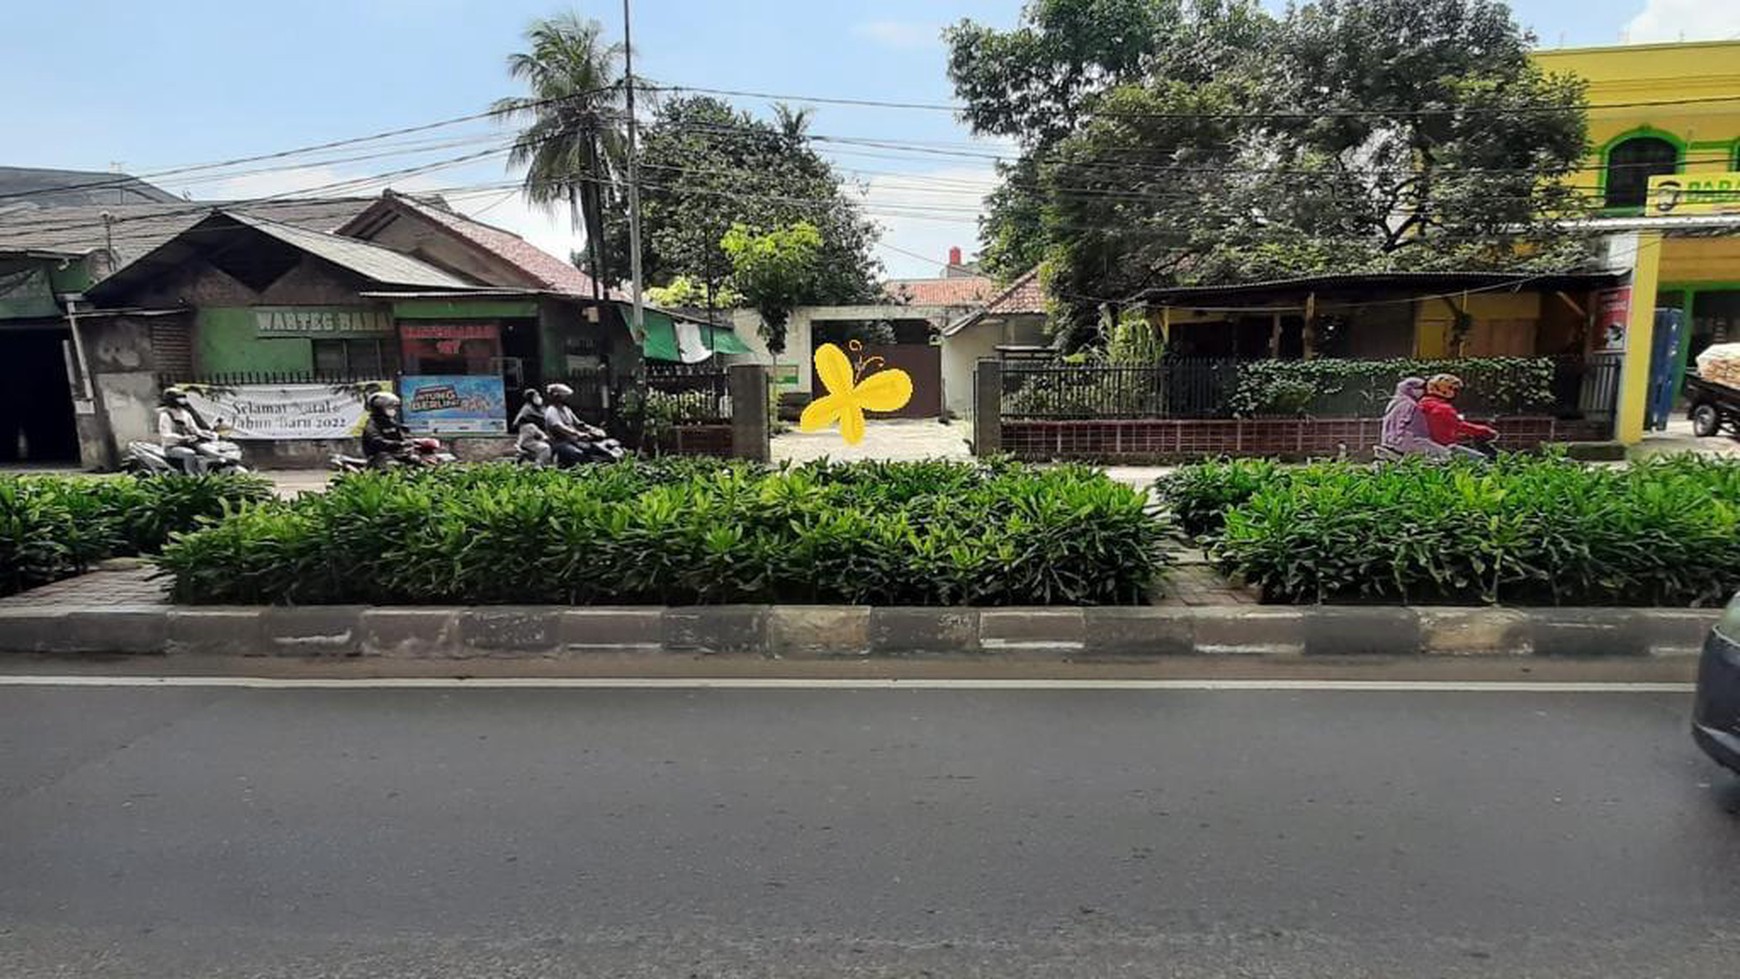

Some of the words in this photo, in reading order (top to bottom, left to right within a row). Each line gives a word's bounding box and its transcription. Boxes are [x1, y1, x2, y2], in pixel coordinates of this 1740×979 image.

[256, 312, 334, 331] WARTEG
[232, 401, 287, 414] Selamat
[230, 415, 272, 429] Tahun
[316, 418, 346, 428] 2022
